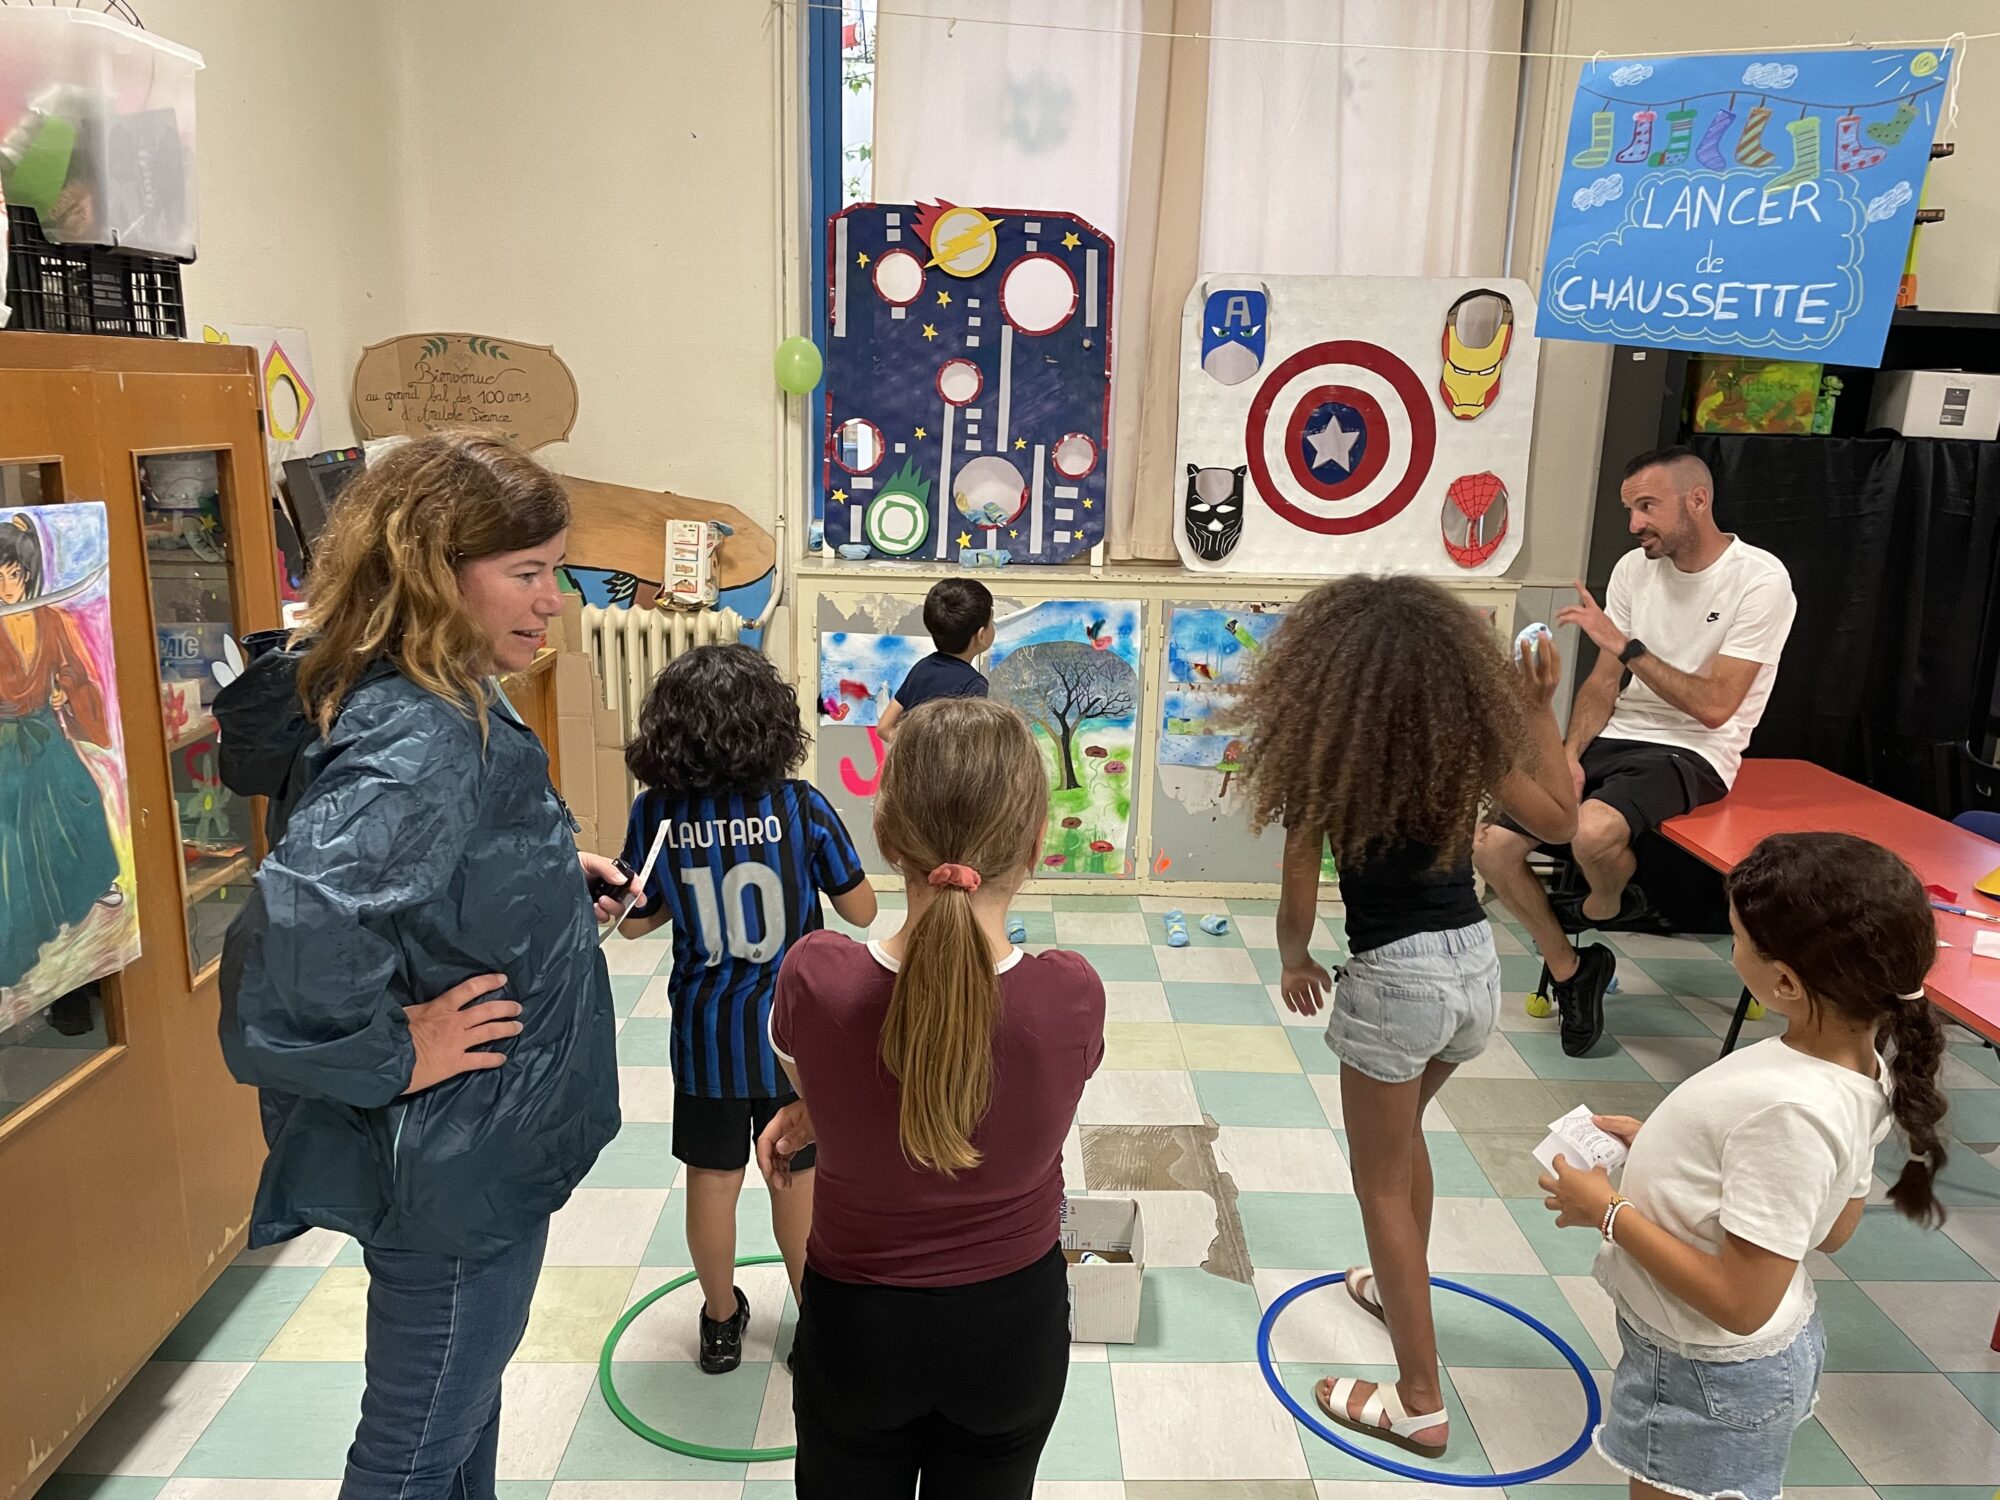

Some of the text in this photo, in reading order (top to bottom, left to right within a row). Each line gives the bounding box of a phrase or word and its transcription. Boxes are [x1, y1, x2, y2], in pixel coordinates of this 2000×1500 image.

[1642, 181, 1822, 231] LANCER
[1696, 239, 1724, 273] de
[1224, 296, 1251, 327] A
[1557, 275, 1838, 324] CHAUSSETTE
[384, 386, 421, 411] grand
[456, 387, 472, 404] des
[477, 390, 504, 404] 100
[507, 392, 531, 403] ans
[468, 407, 512, 423] France
[667, 815, 783, 850] LAUTARO
[680, 861, 787, 968] 10
